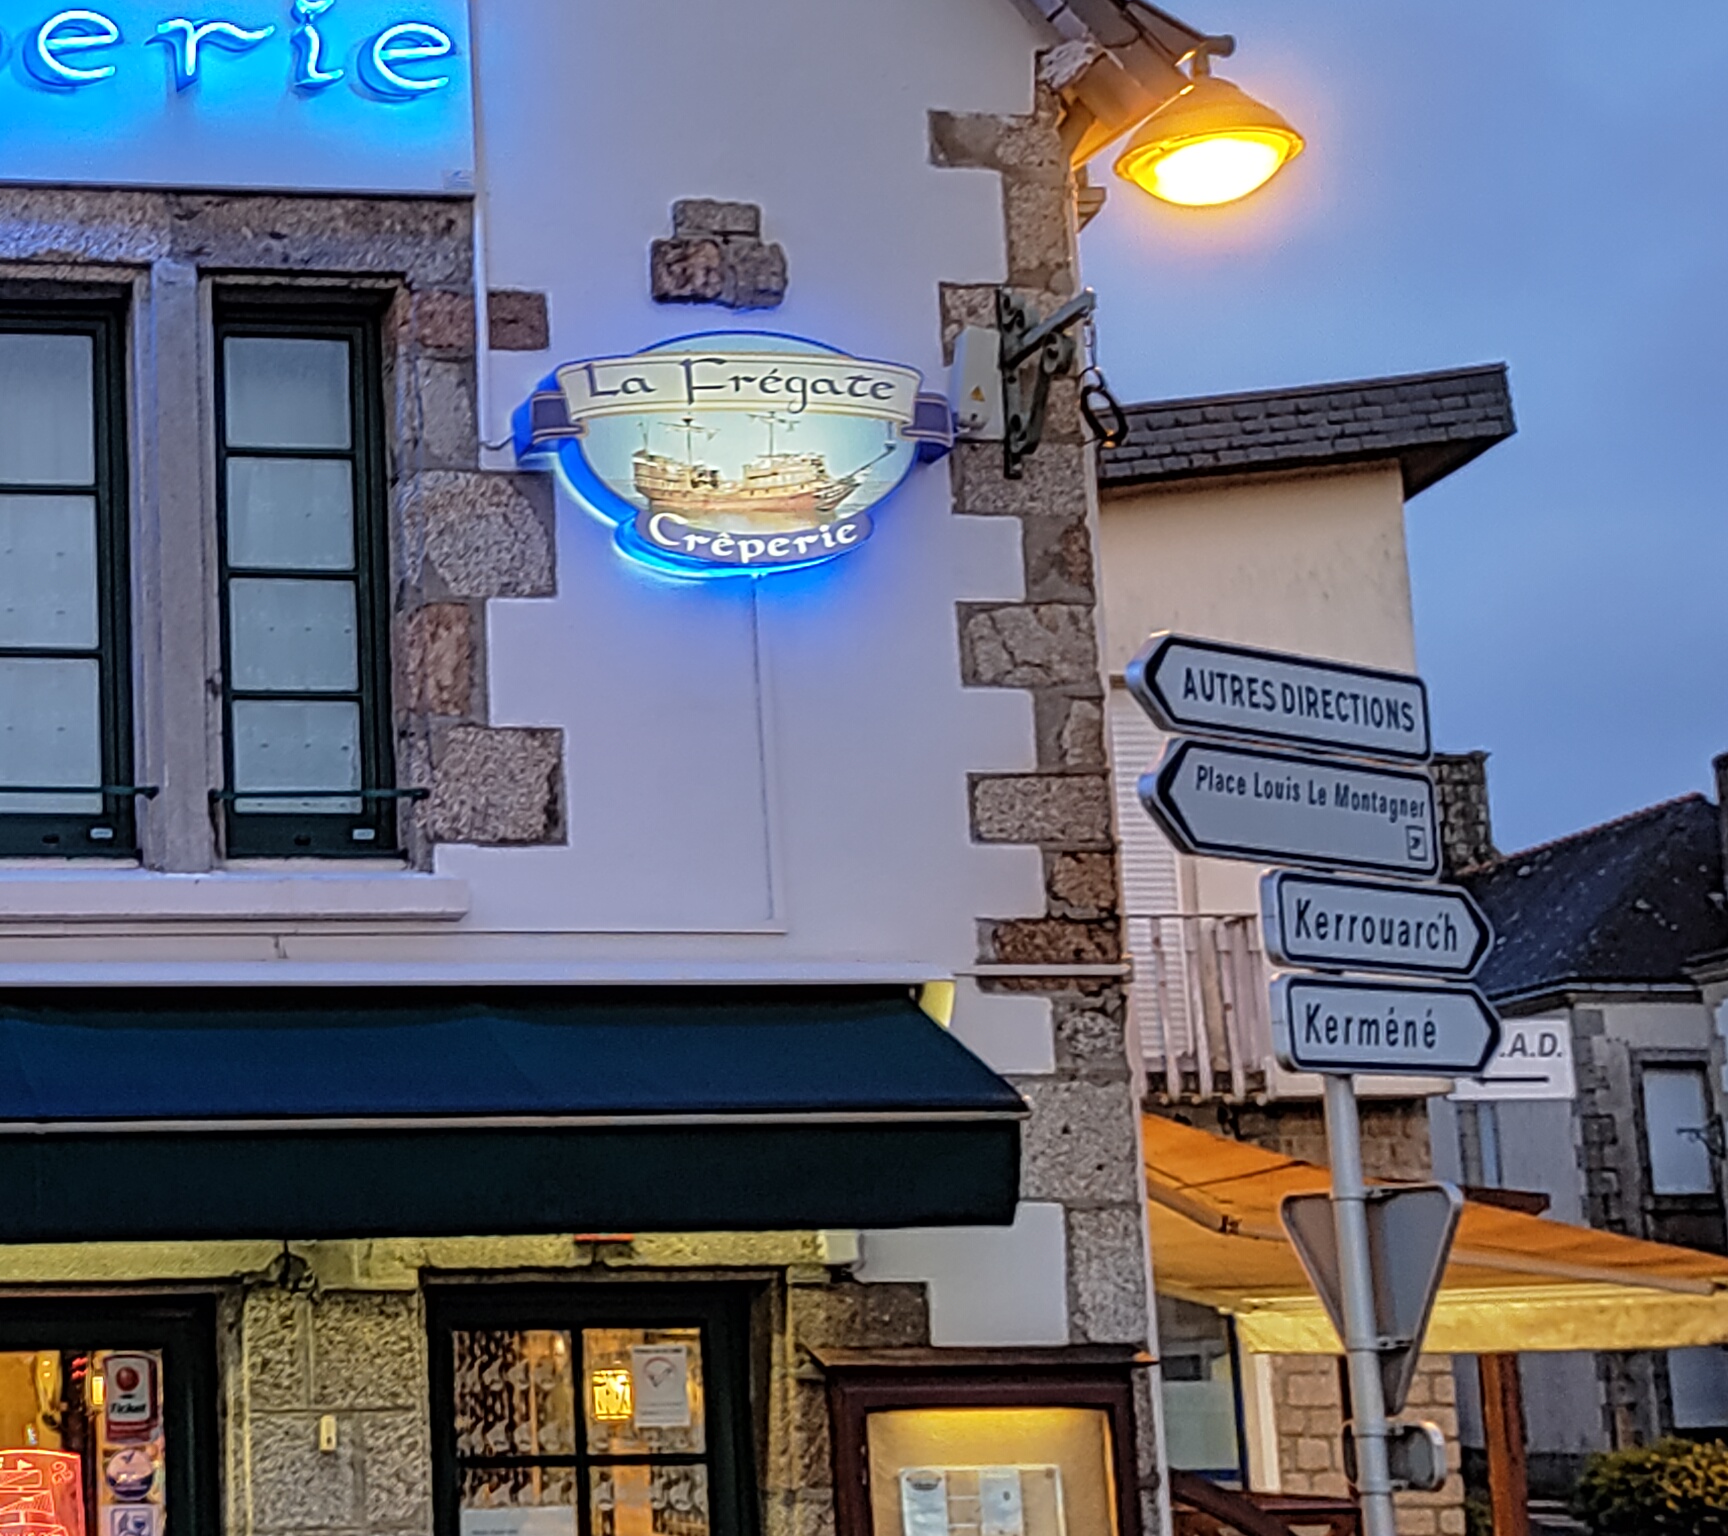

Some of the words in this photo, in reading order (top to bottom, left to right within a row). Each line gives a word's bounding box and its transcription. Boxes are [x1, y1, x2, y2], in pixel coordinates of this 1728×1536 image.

[584, 362, 657, 398] La
[679, 357, 896, 414] Frégate
[649, 511, 859, 564] Crêperie
[1183, 667, 1277, 712] AUTRES
[1281, 682, 1416, 733] DIRECTIONS
[1195, 764, 1247, 796] Place
[1254, 771, 1301, 805] Louis
[1308, 779, 1327, 806] Le
[1334, 782, 1425, 824] Montagner
[1304, 1003, 1438, 1050] Kerméné
